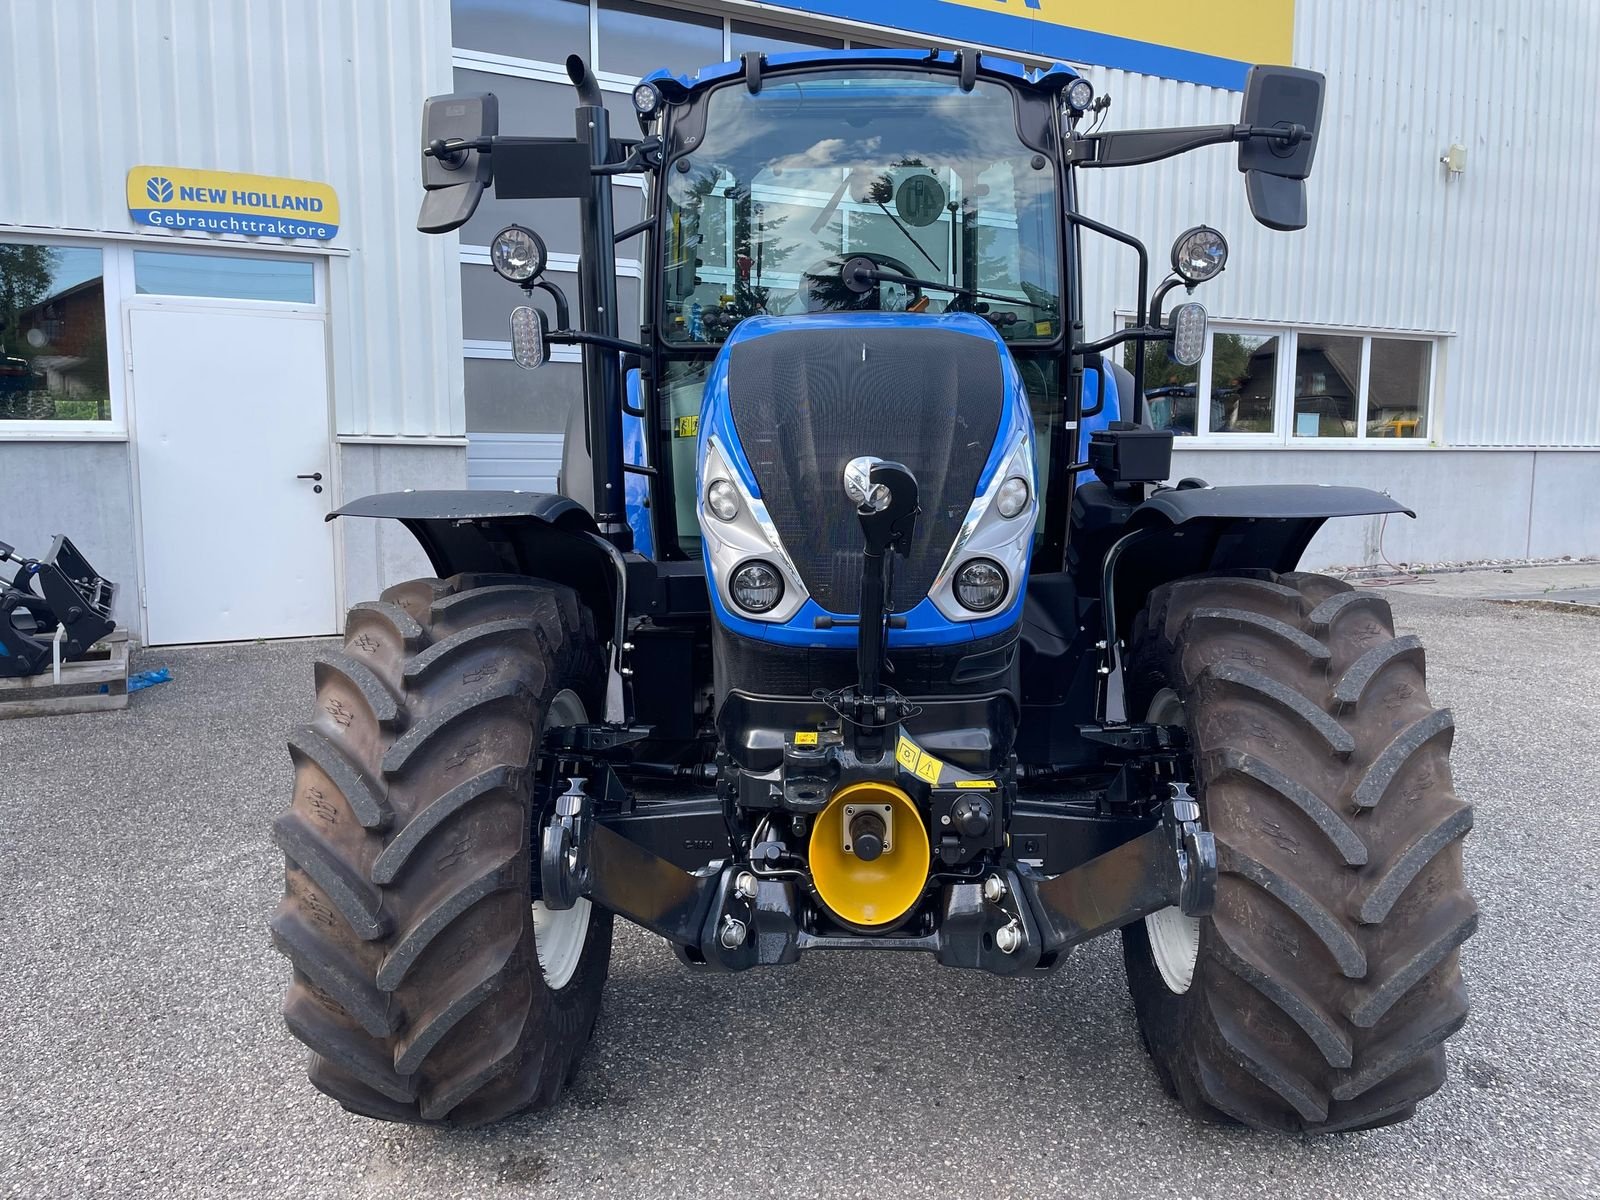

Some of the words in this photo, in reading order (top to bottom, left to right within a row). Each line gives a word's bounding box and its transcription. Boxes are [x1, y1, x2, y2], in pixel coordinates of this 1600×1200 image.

[180, 186, 227, 204] NEW
[231, 190, 323, 212] HOLLAND
[148, 210, 326, 237] Gebrauchttraktore
